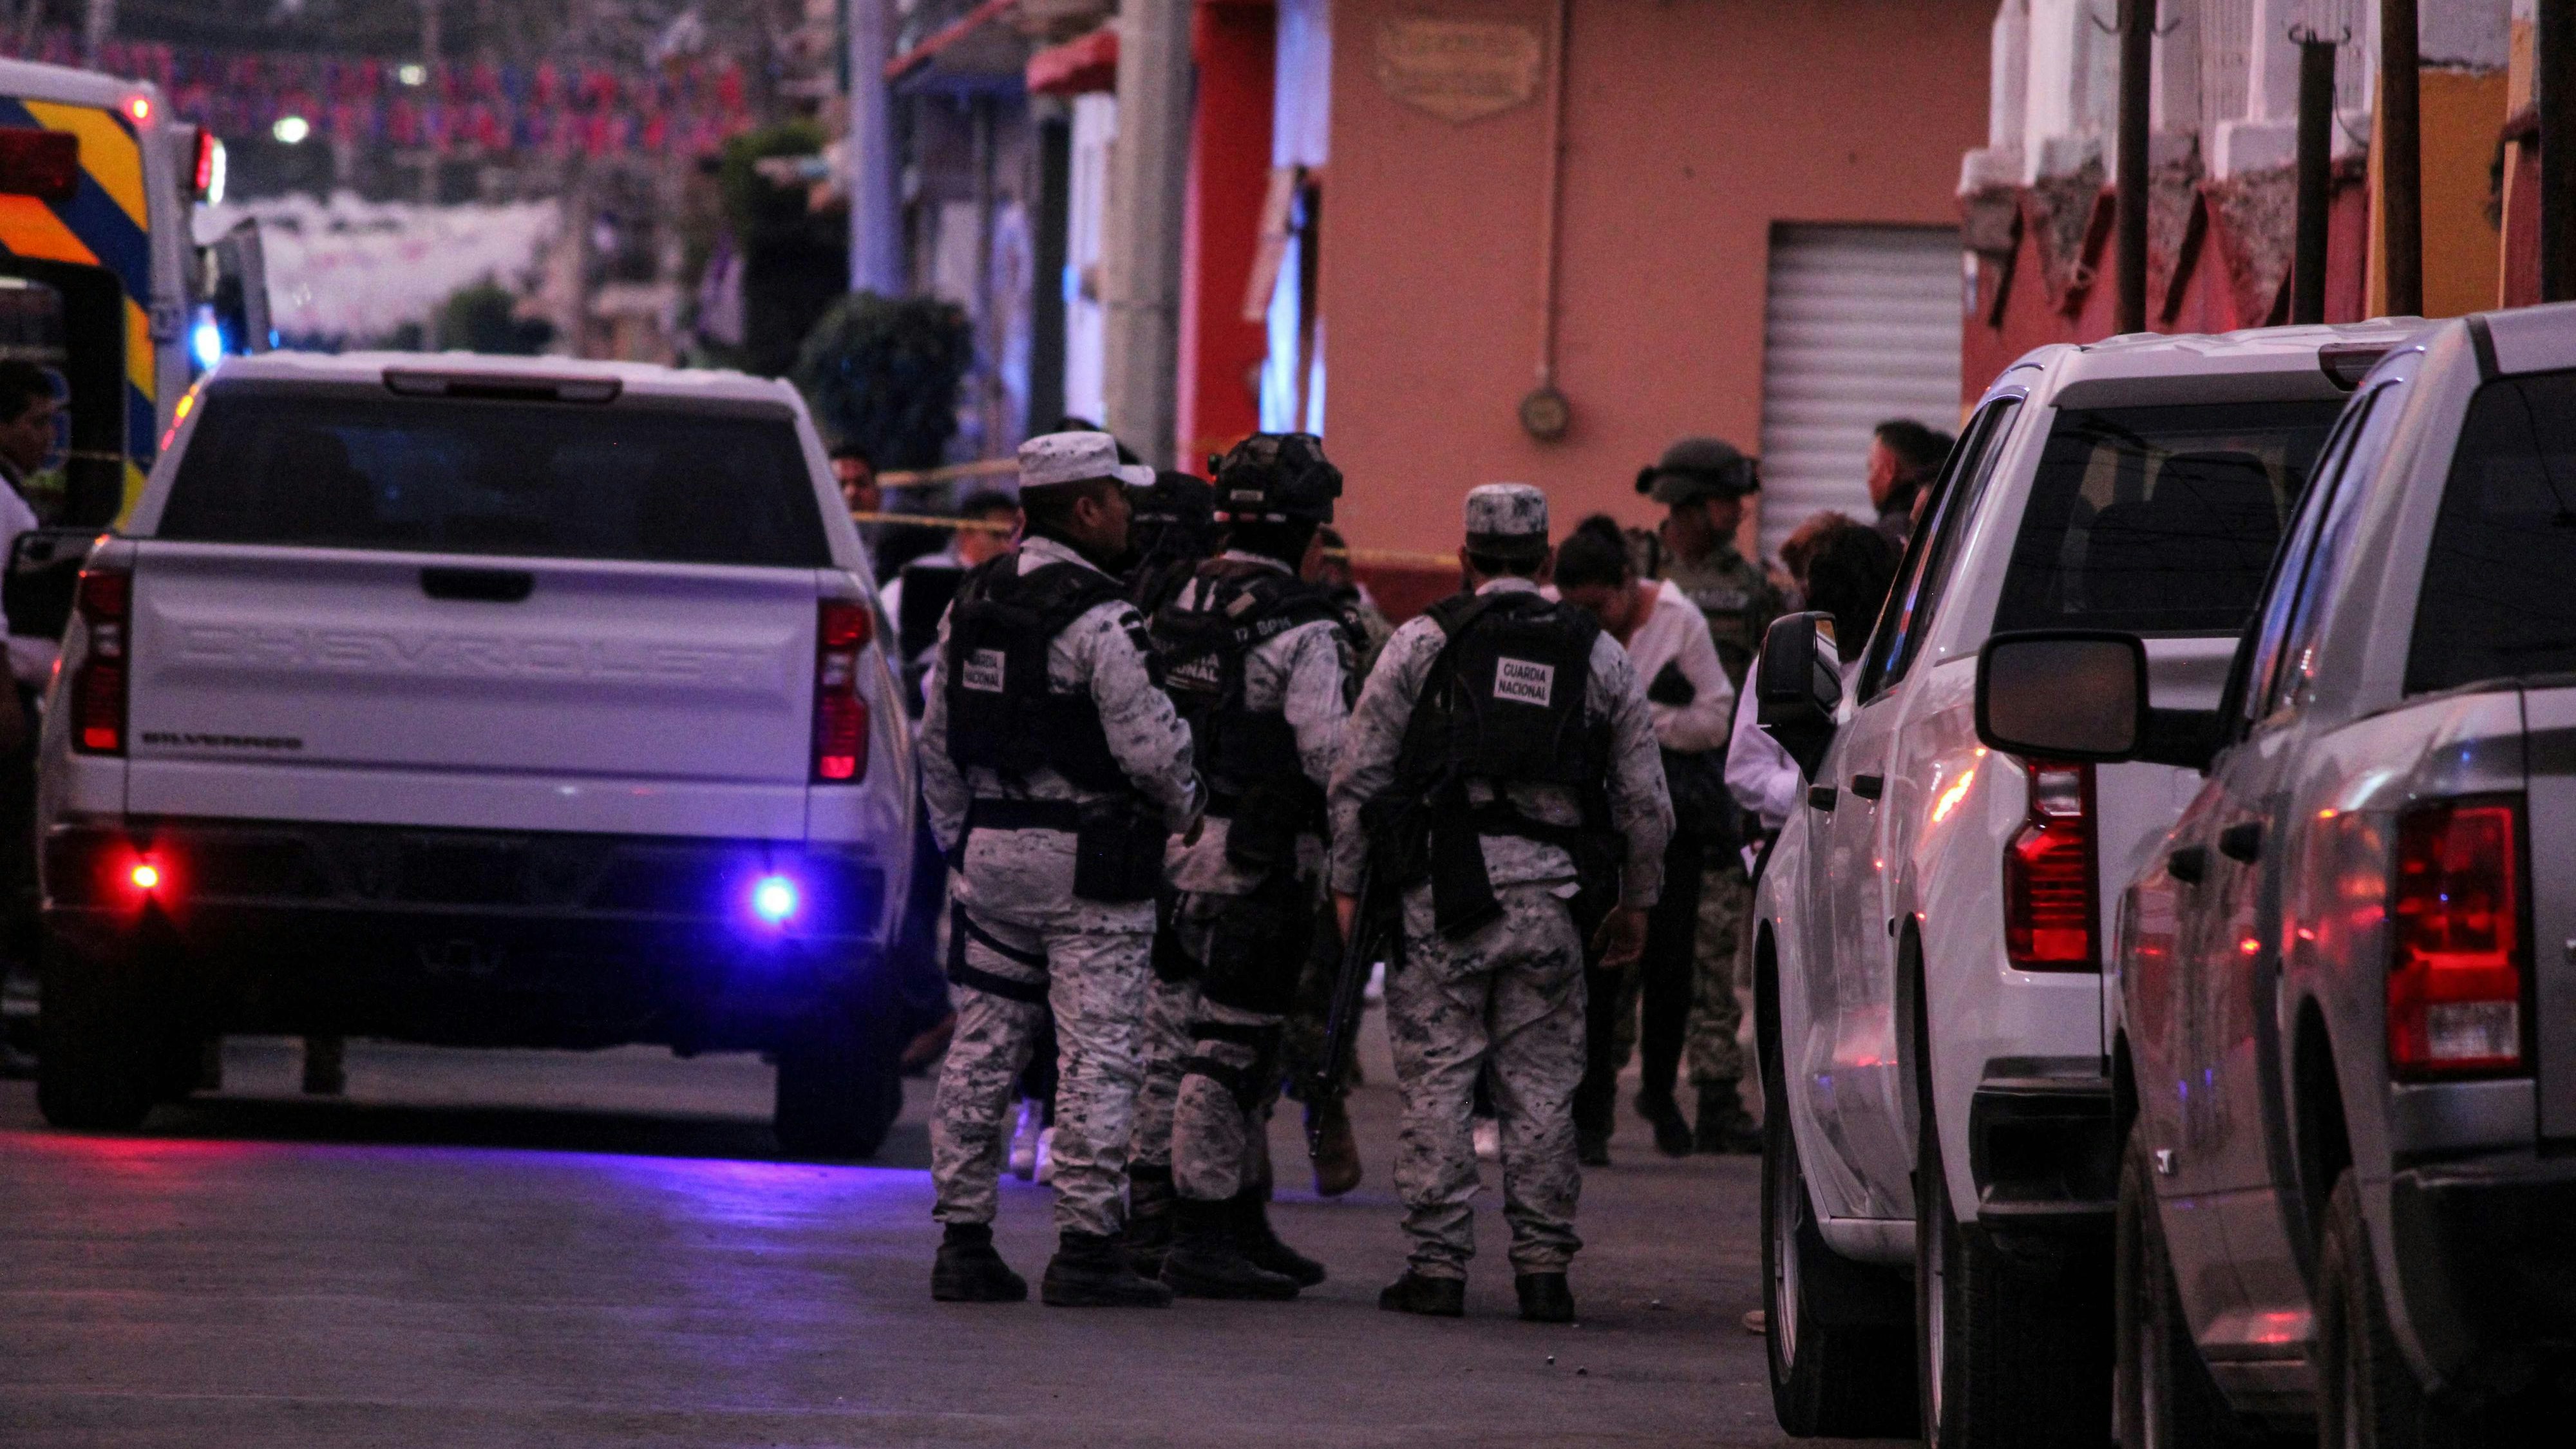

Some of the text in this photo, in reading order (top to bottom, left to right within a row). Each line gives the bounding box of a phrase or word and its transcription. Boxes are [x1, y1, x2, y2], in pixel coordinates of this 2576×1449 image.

[179, 625, 768, 679] CHEVROLET
[1503, 662, 1546, 683] GUARDIA
[1498, 679, 1546, 701] NACIONAL
